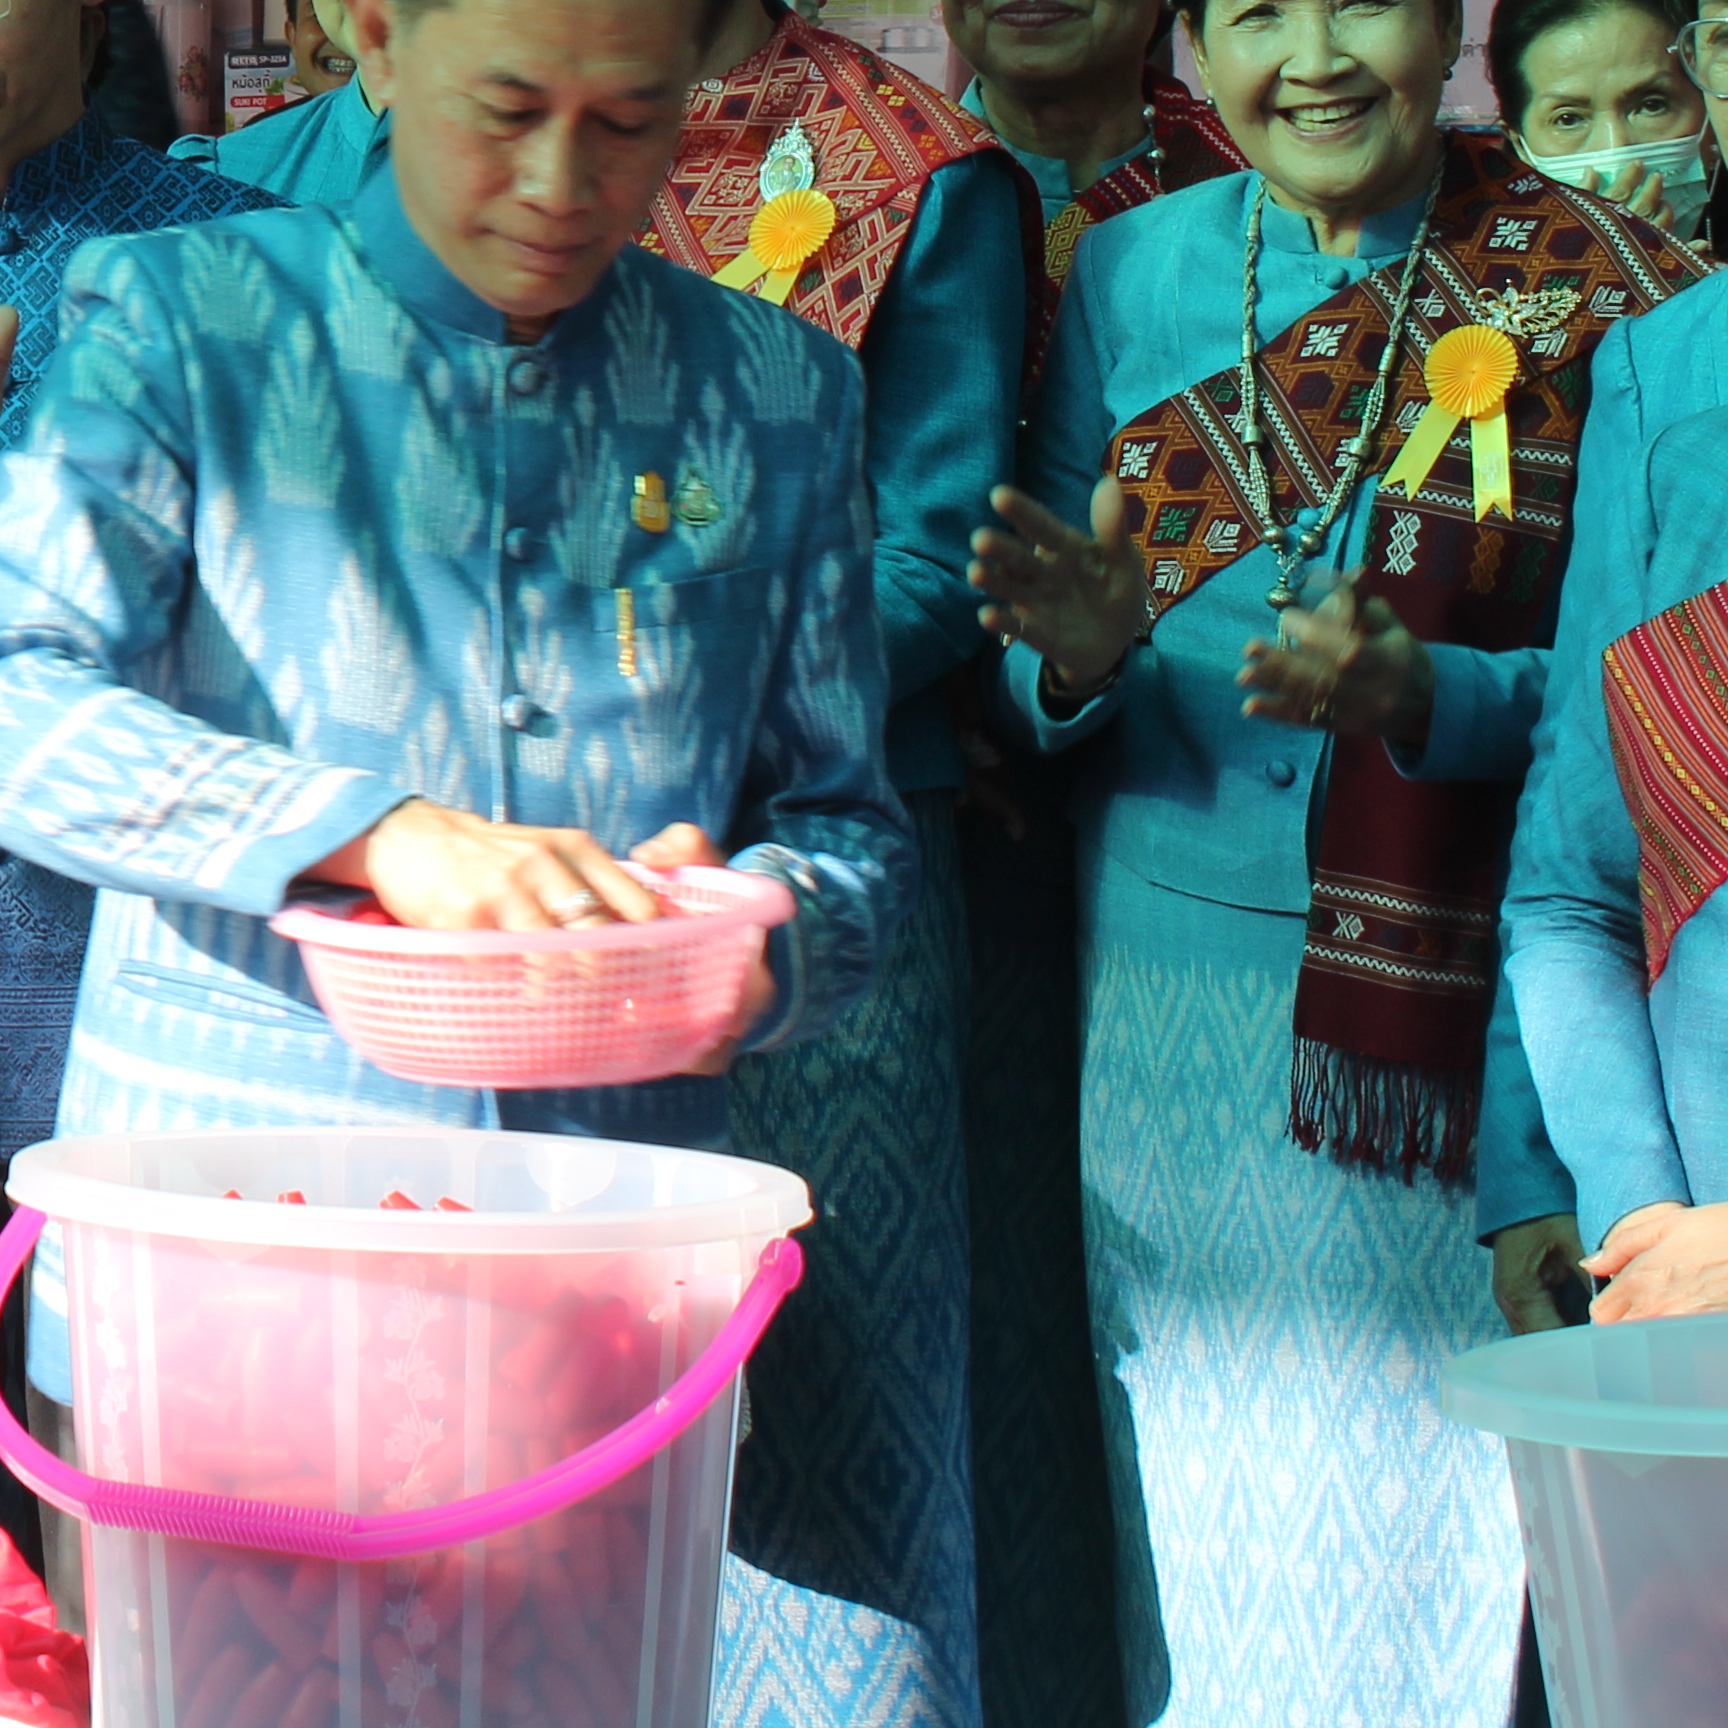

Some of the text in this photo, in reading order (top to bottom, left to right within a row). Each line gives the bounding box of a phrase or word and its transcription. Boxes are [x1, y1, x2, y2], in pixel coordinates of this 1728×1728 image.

[232, 69, 272, 94] หม้อสุกี้
[233, 96, 268, 107] SUKI POT
